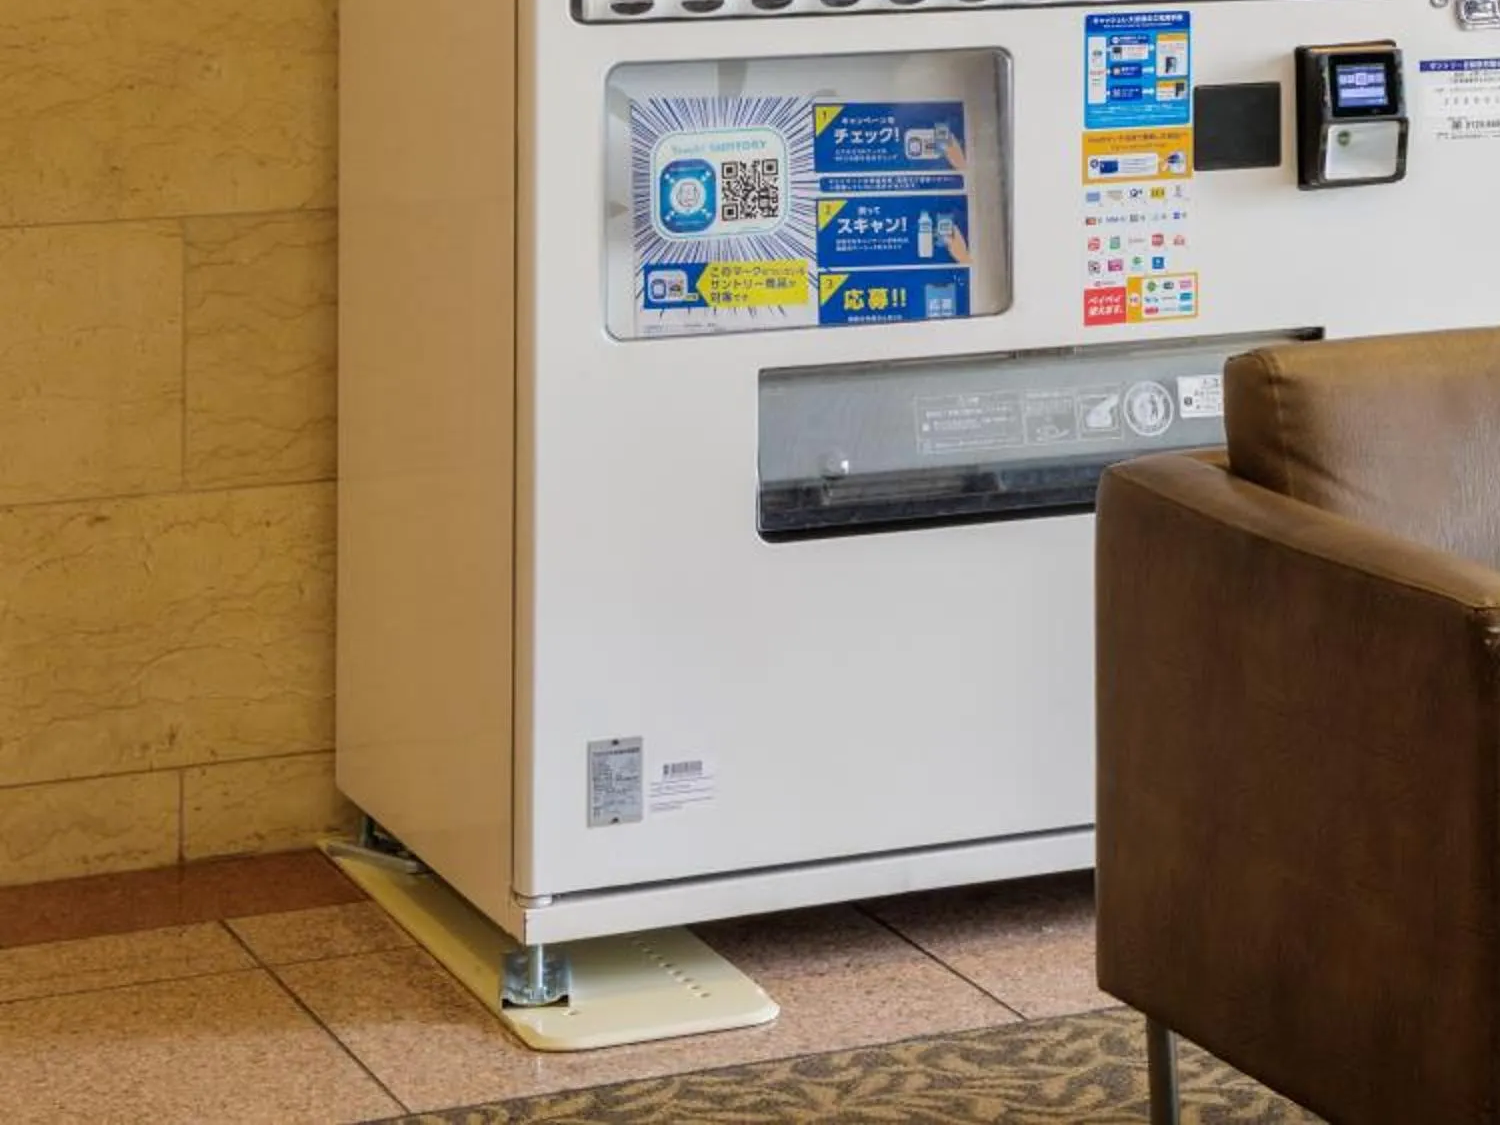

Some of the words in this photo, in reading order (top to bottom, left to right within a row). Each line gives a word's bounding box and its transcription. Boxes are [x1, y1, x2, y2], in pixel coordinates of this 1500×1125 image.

[833, 127, 900, 145] チェック!
[837, 216, 908, 235] スキャン!
[843, 287, 908, 311] 応募!!
